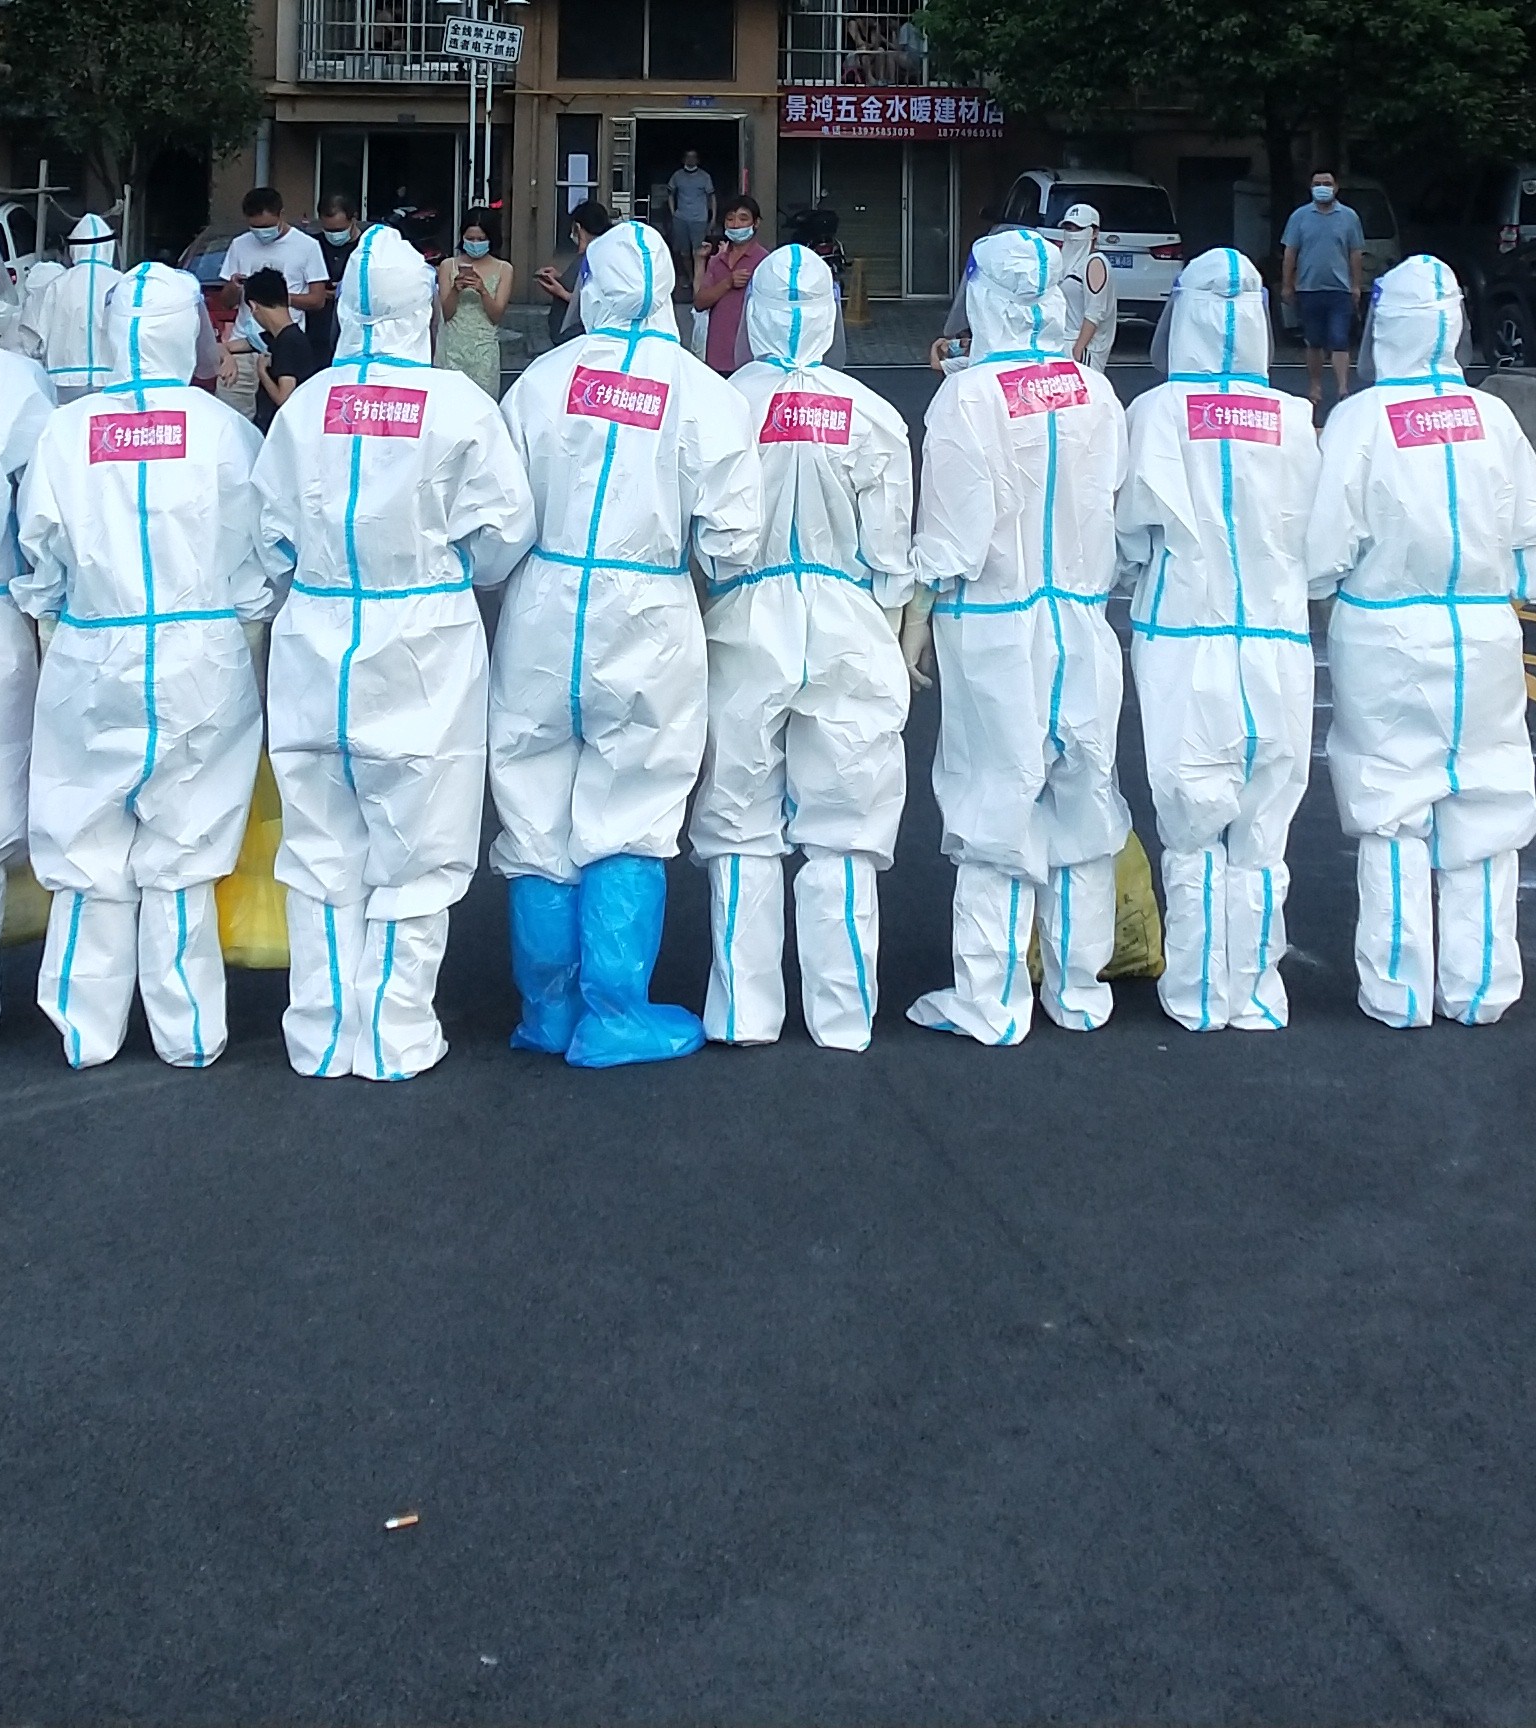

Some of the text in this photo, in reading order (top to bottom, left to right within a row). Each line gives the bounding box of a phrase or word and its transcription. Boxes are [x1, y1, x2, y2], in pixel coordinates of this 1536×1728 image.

[450, 23, 518, 43] 全线禁止停车
[448, 37, 516, 57] 违者电子抓拍
[785, 95, 1004, 124] 景鸿五金水暖建材店
[353, 399, 420, 424] 宁乡市妇幼保健院
[596, 384, 662, 416] 宁乡市妇幼保健院
[784, 406, 847, 430] 宁乡市妇幼保健院
[1215, 406, 1278, 431] 宁乡市妇幼保健院
[1416, 408, 1478, 432] 宁乡市妇幼保健院
[115, 424, 182, 447] 宁乡市妇幼保健院
